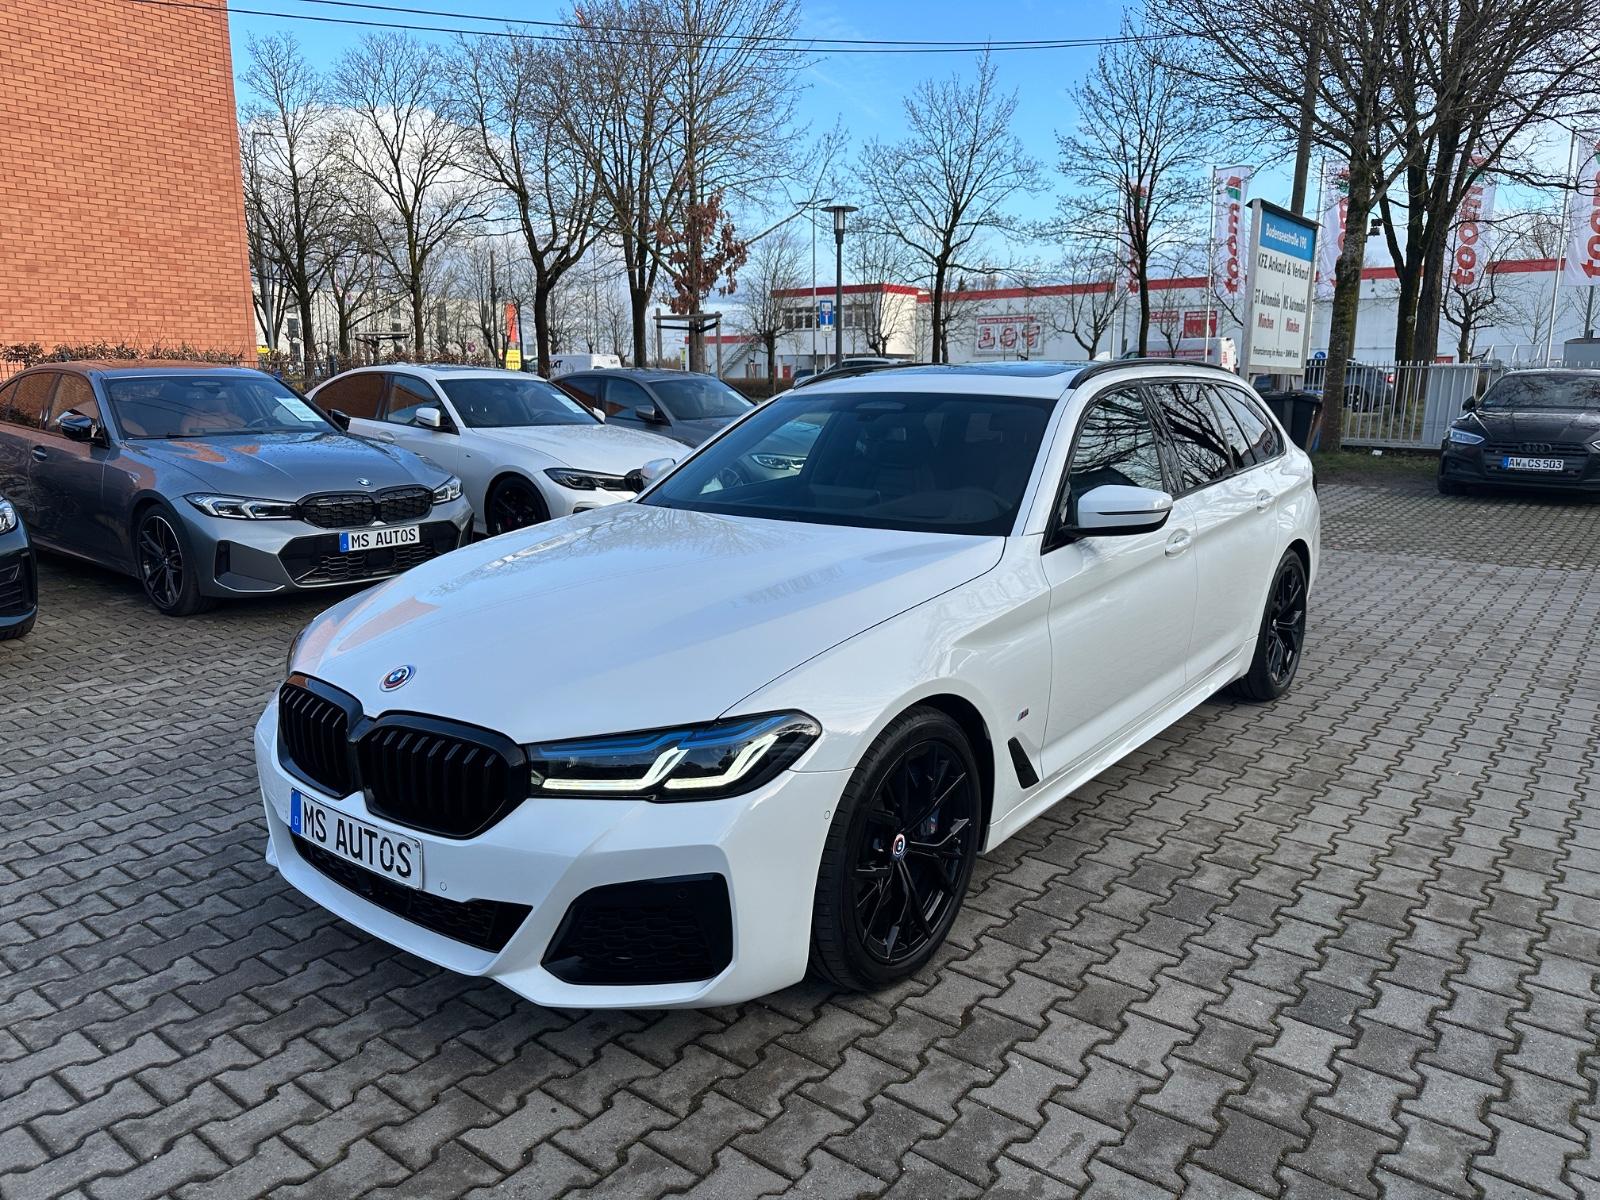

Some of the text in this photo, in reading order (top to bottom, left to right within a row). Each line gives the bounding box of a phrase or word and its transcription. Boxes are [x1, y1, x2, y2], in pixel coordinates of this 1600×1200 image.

[1224, 202, 1240, 294] toom
[1258, 251, 1309, 280] KFZ Ankauf & Verkauf
[1509, 458, 1562, 469] AW CS 503
[351, 533, 370, 549] MS
[375, 528, 416, 546] AUTOS
[303, 801, 327, 842] MS
[336, 818, 412, 878] AUTOS
